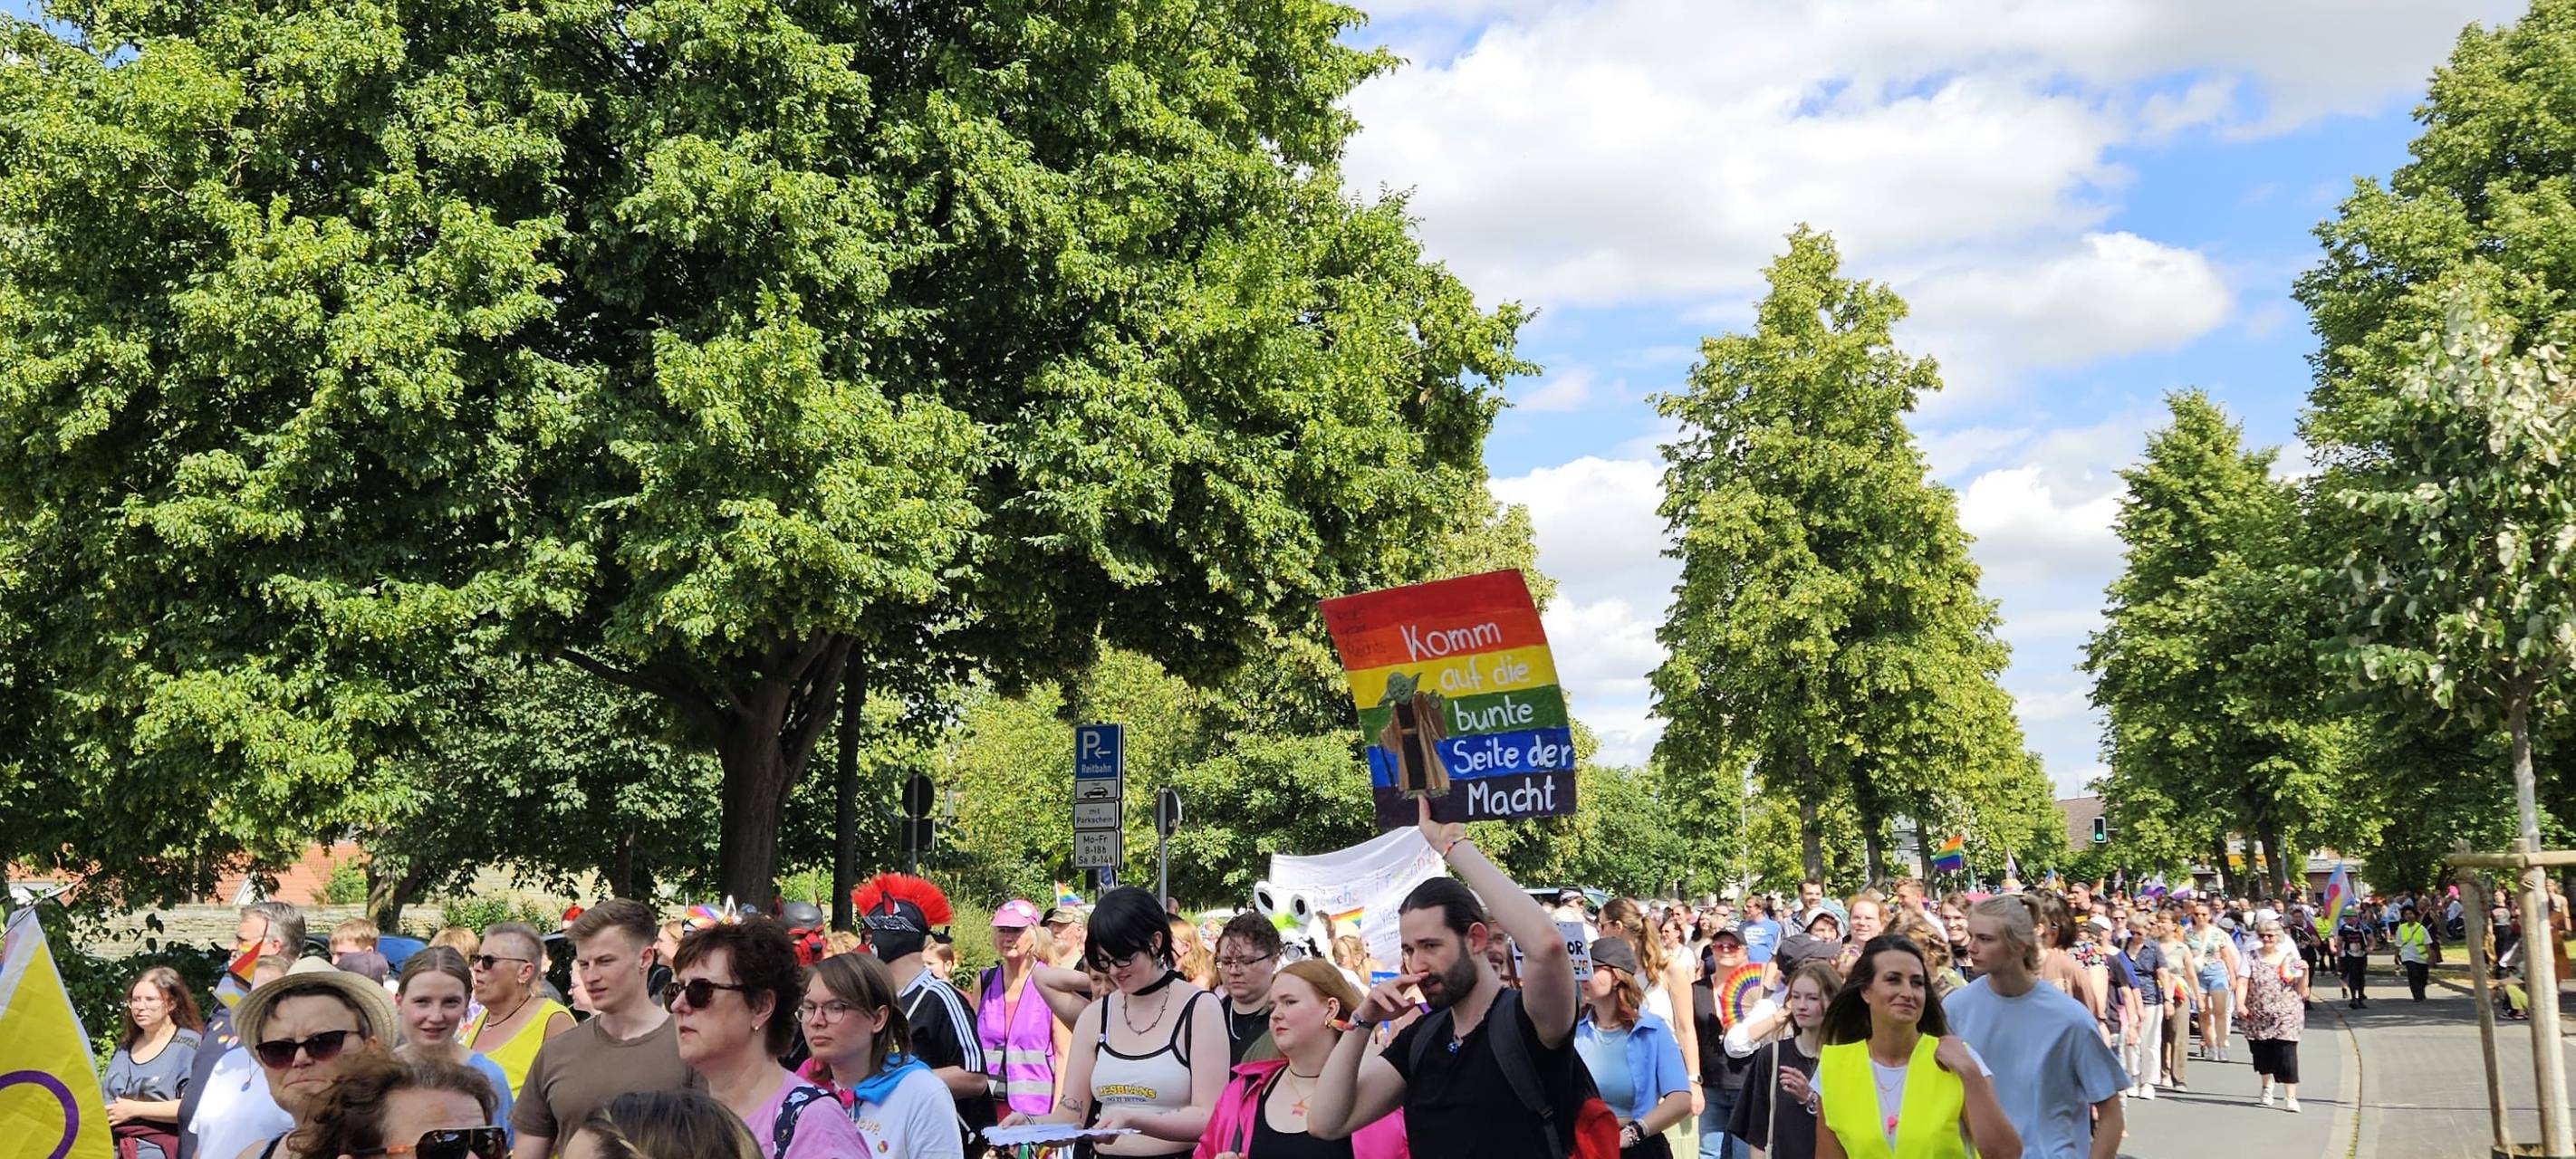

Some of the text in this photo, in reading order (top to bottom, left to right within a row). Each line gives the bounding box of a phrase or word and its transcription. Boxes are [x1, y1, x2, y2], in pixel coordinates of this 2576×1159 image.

[1399, 621, 1502, 663] Komm
[1439, 655, 1531, 692] auf die
[1453, 694, 1533, 732] bunte
[1082, 731, 1101, 760] P
[1453, 734, 1573, 774] Seite der
[1081, 763, 1112, 774] Reitbahn
[1467, 775, 1556, 817] Macht
[1089, 808, 1101, 816] mit
[1076, 816, 1112, 825] Parkschein
[1083, 835, 1108, 844] Mo-Fr
[1085, 846, 1107, 855] 8-18h
[1078, 855, 1113, 865] Sa 8-14h
[1567, 940, 1584, 955] OR
[1097, 1085, 1157, 1099] LESBIANS
